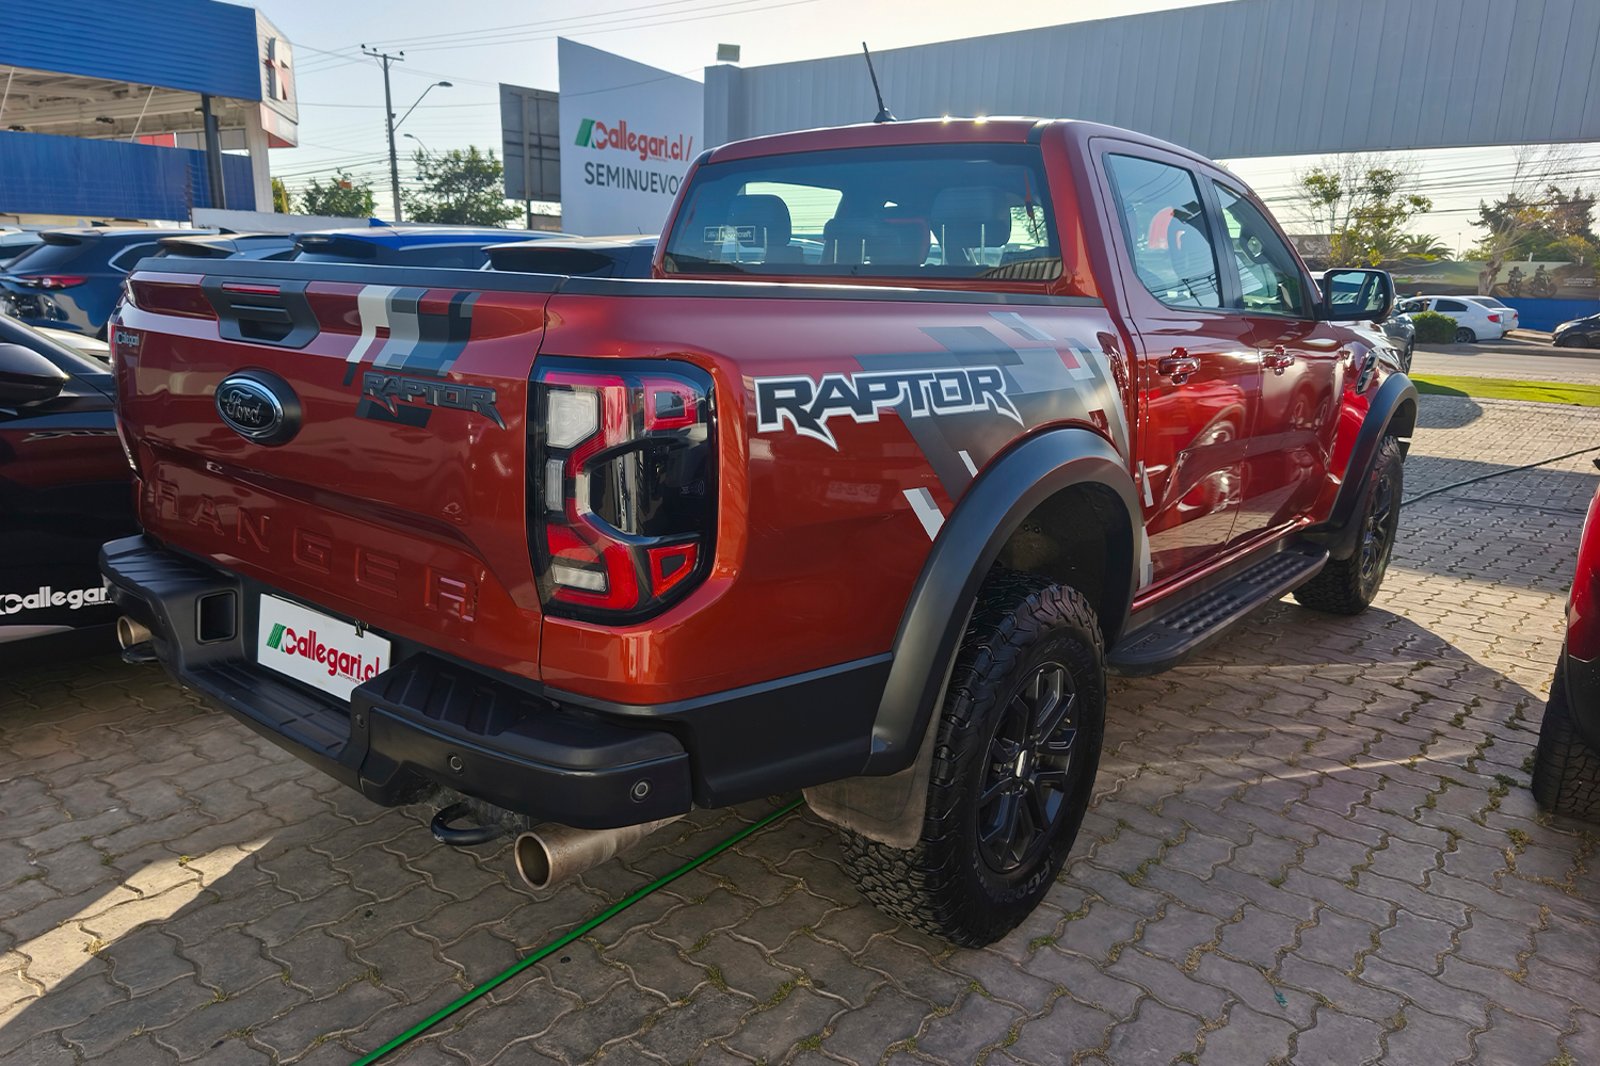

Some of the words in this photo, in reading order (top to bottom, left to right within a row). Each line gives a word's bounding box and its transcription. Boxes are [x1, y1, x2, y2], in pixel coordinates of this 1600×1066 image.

[223, 389, 262, 424] Ford
[363, 371, 507, 431] RAPTOR
[753, 365, 1025, 452] RAPTOR
[155, 478, 475, 621] RANGER
[5, 586, 111, 614] Callegar
[286, 628, 380, 682] Callegari.cl
